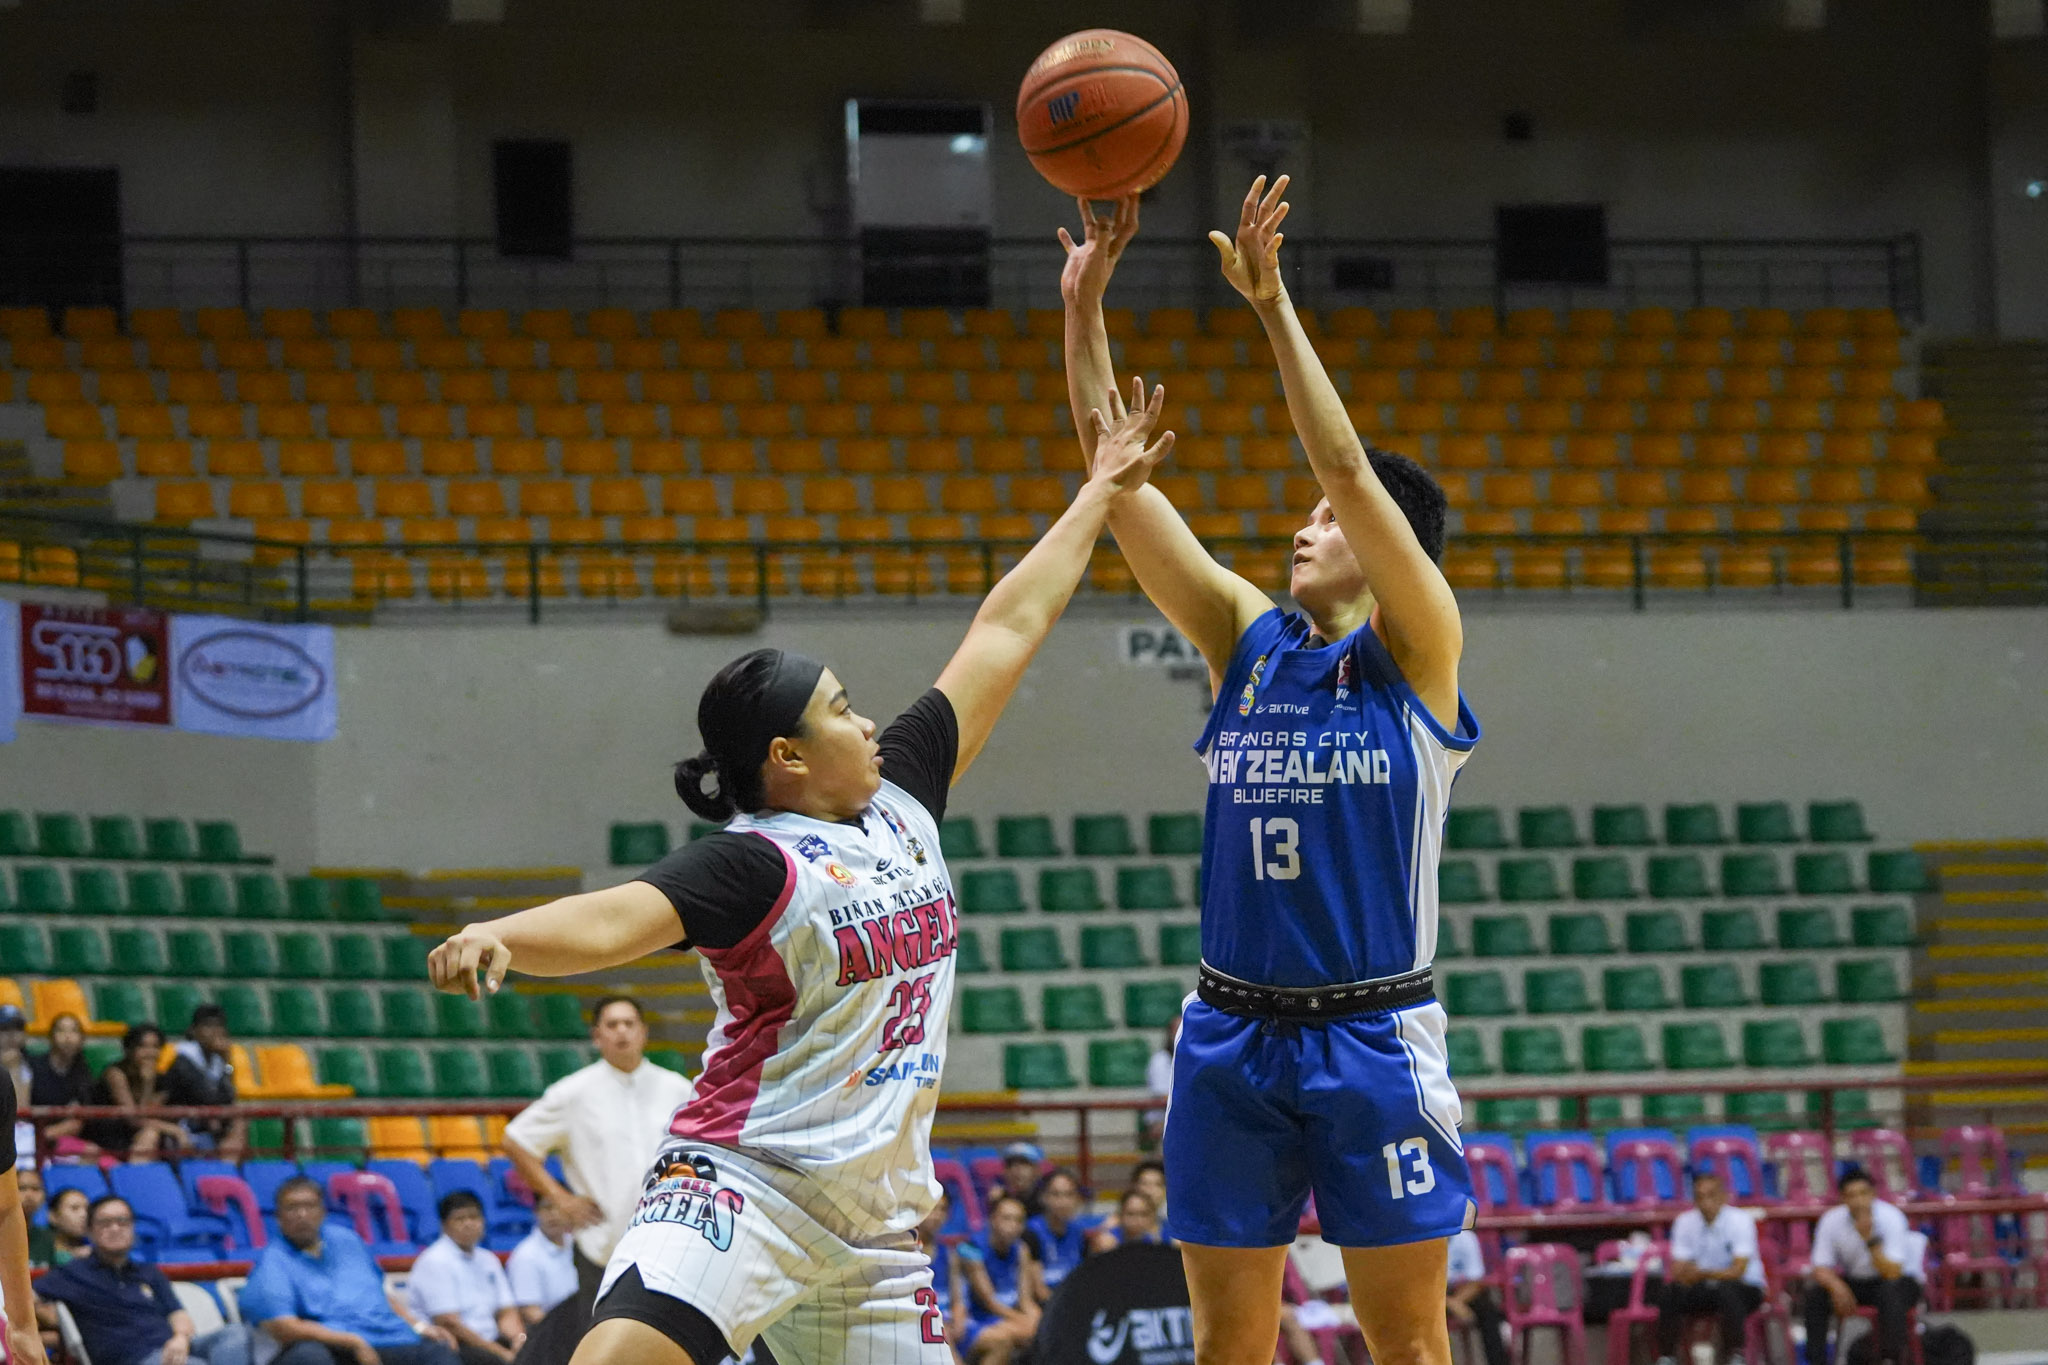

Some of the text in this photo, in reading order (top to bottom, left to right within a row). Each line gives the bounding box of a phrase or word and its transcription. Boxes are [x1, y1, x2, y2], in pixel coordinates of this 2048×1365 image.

[1130, 628, 1201, 659] PA
[1219, 731, 1369, 747] BATANGAS CITY
[1246, 749, 1390, 785] ZEALAND
[1233, 788, 1323, 804] BLUEFIRE
[1249, 816, 1300, 881] 13
[829, 897, 886, 926] BIÑAN
[1383, 1137, 1436, 1200] 13
[914, 1287, 948, 1344] 2
